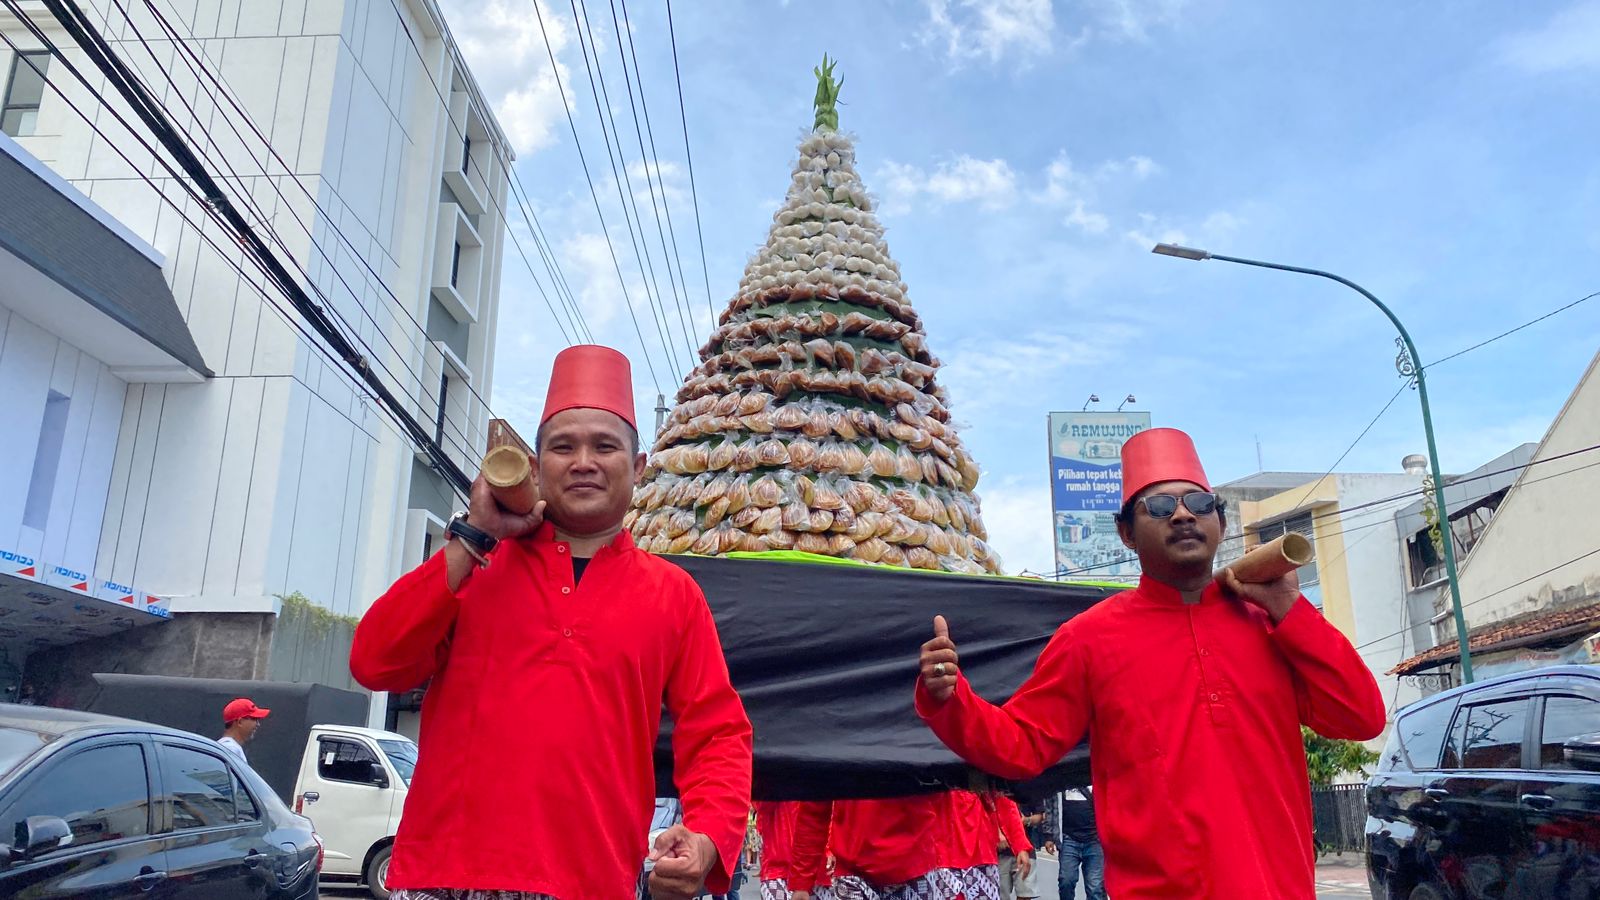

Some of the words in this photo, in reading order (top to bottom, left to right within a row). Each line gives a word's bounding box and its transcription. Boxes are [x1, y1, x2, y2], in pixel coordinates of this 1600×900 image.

[1058, 469, 1085, 480] Pilihan
[1086, 469, 1108, 481] tepat
[1065, 481, 1091, 491] rumah
[1092, 482, 1120, 493] tangga
